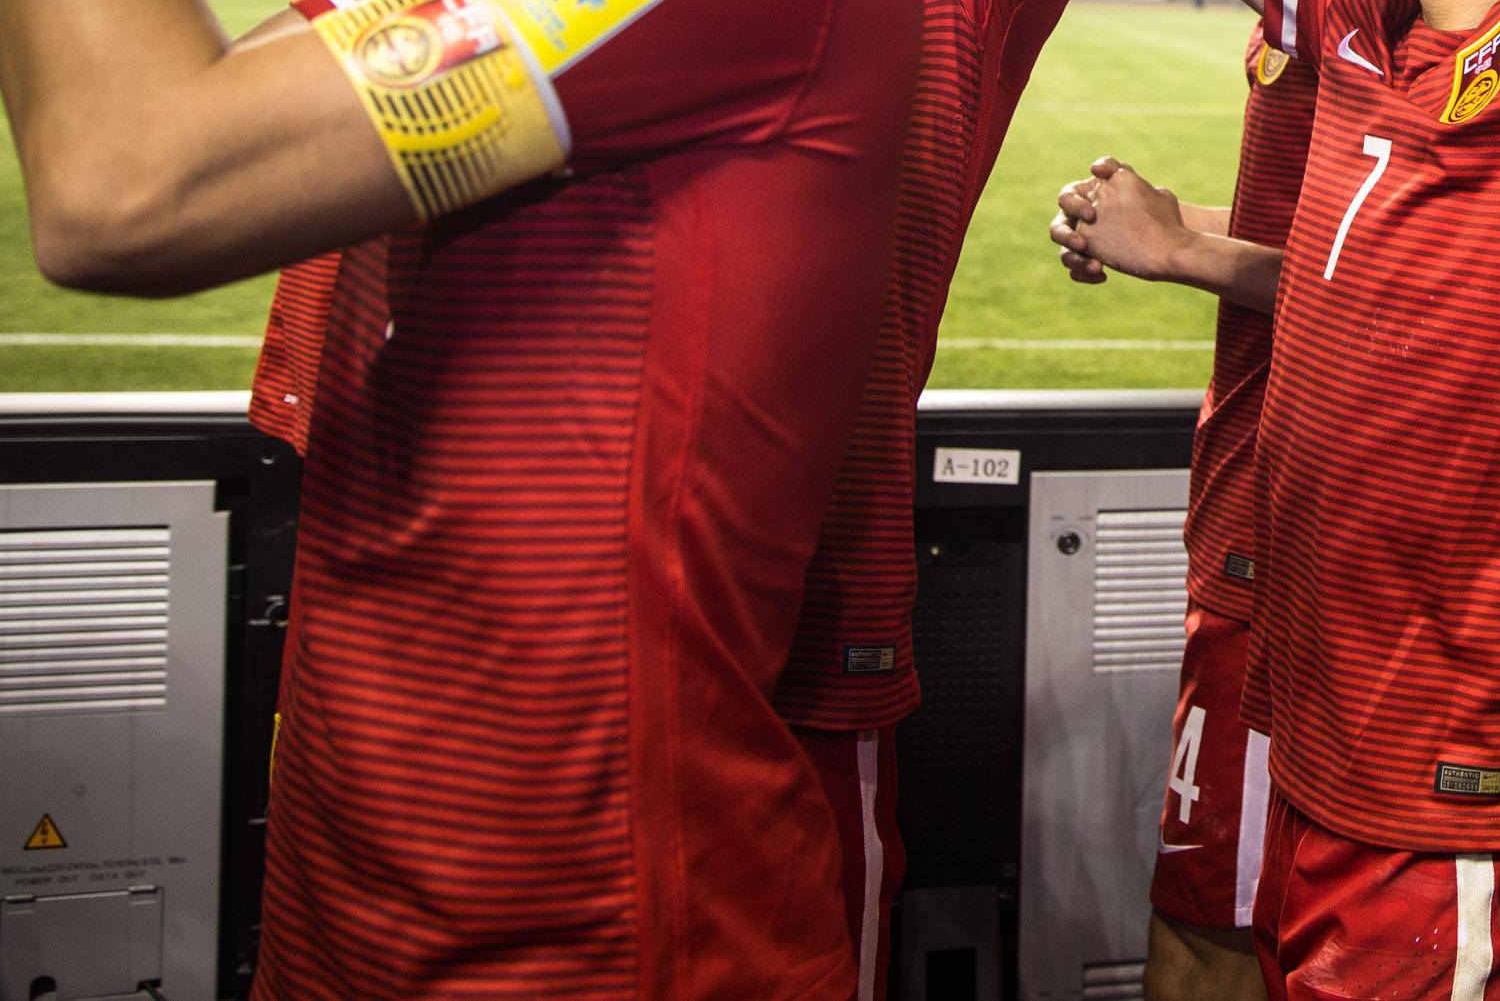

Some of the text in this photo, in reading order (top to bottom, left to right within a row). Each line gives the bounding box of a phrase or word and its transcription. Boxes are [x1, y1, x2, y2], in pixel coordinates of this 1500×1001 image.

[1323, 135, 1393, 281] 7
[942, 458, 1009, 478] A-102
[1170, 705, 1207, 825] 4
[1444, 769, 1480, 779] AUTHENTIC
